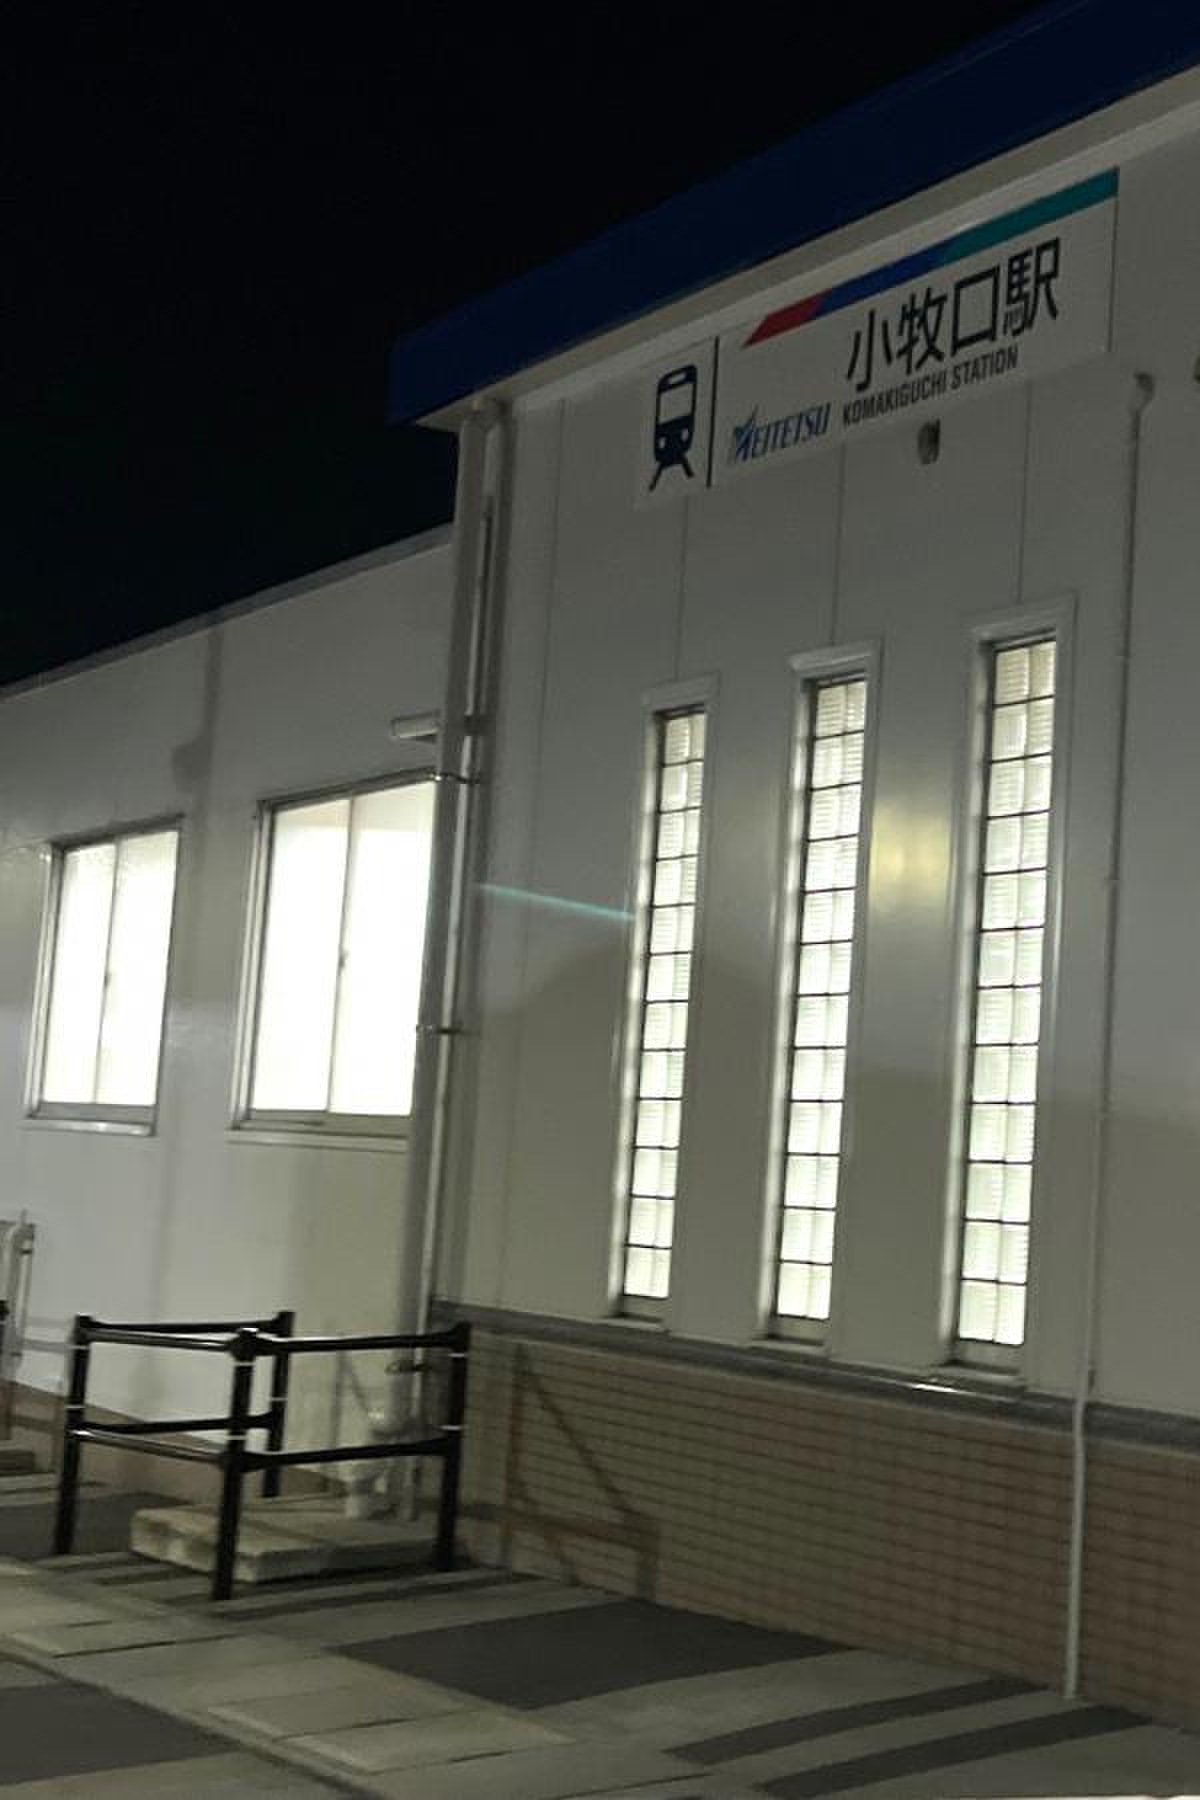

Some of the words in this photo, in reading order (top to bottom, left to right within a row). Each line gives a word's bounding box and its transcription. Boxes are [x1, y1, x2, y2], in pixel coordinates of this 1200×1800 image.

[845, 238, 1060, 393] 小牧口駅
[843, 368, 947, 426] KOMAKIGUCHI
[951, 343, 1019, 390] STATION
